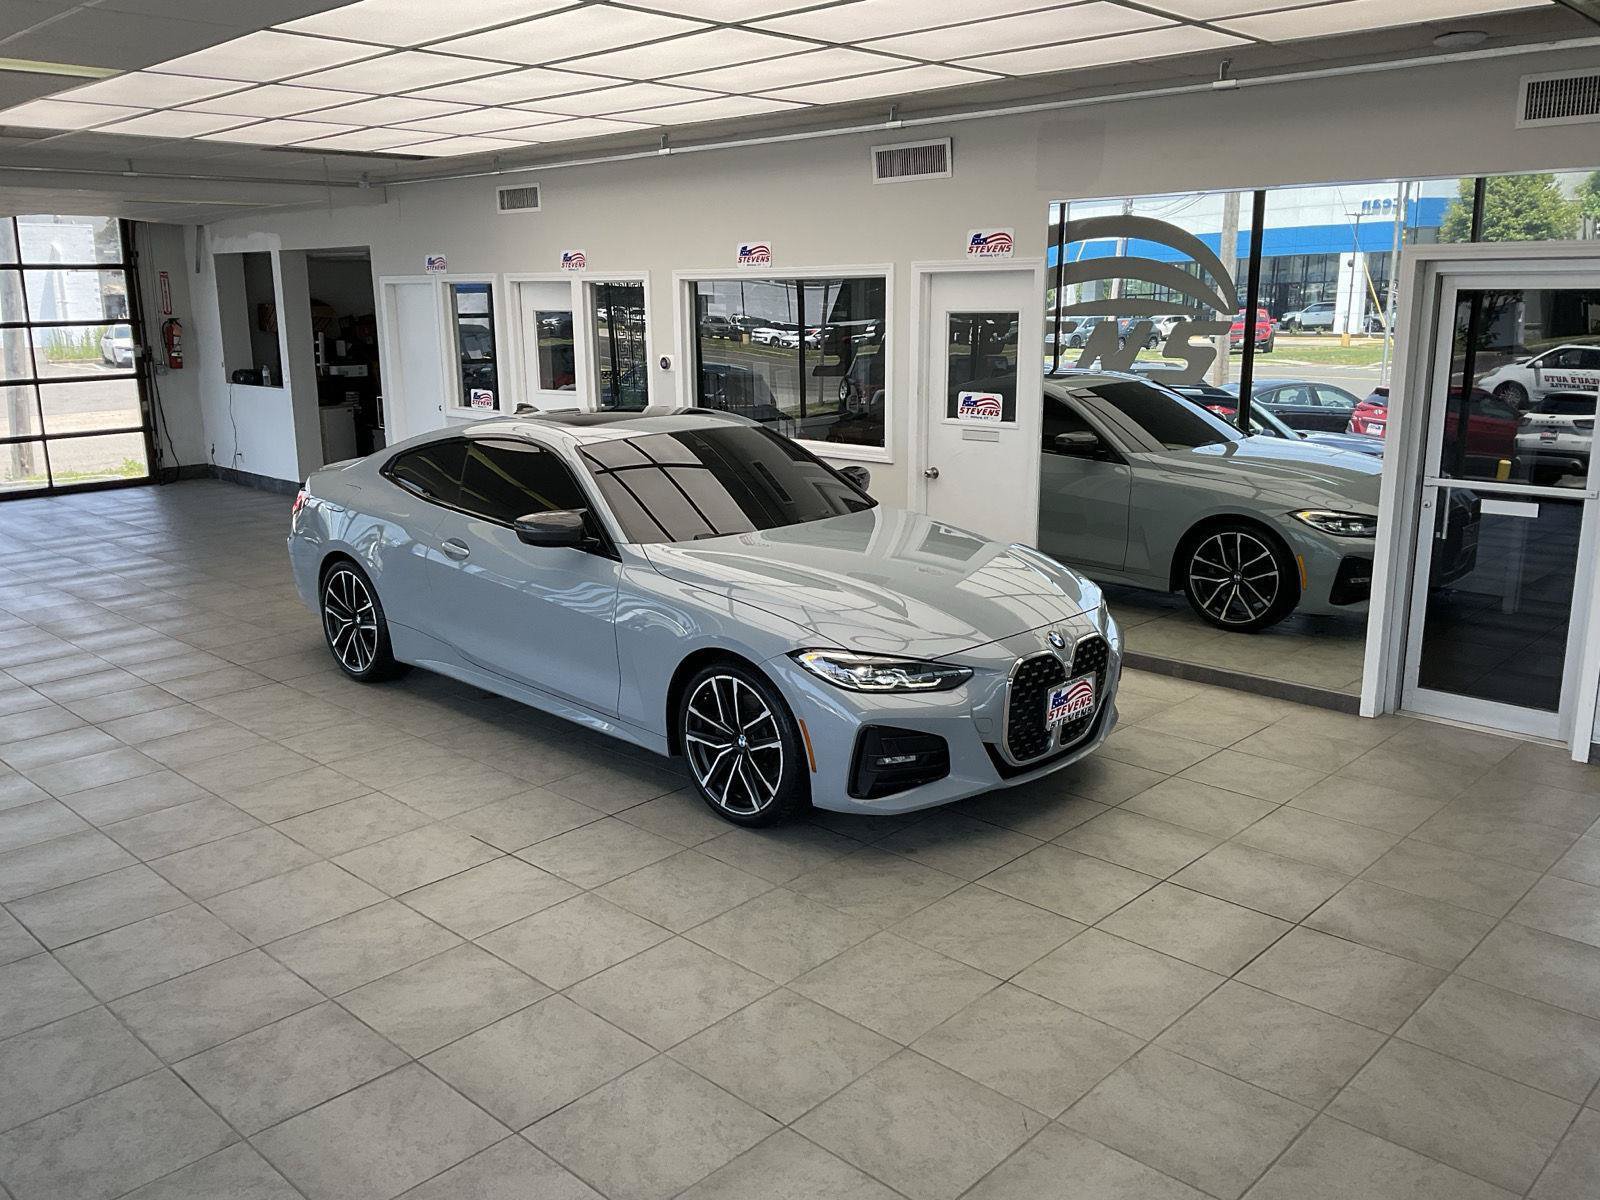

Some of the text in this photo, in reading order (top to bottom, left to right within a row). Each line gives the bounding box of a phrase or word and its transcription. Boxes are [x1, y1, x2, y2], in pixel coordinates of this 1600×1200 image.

[968, 244, 1012, 253] STEVENS
[738, 255, 770, 264] STEVENS
[959, 406, 1001, 417] STEVENS
[1048, 694, 1093, 721] STEVENS
